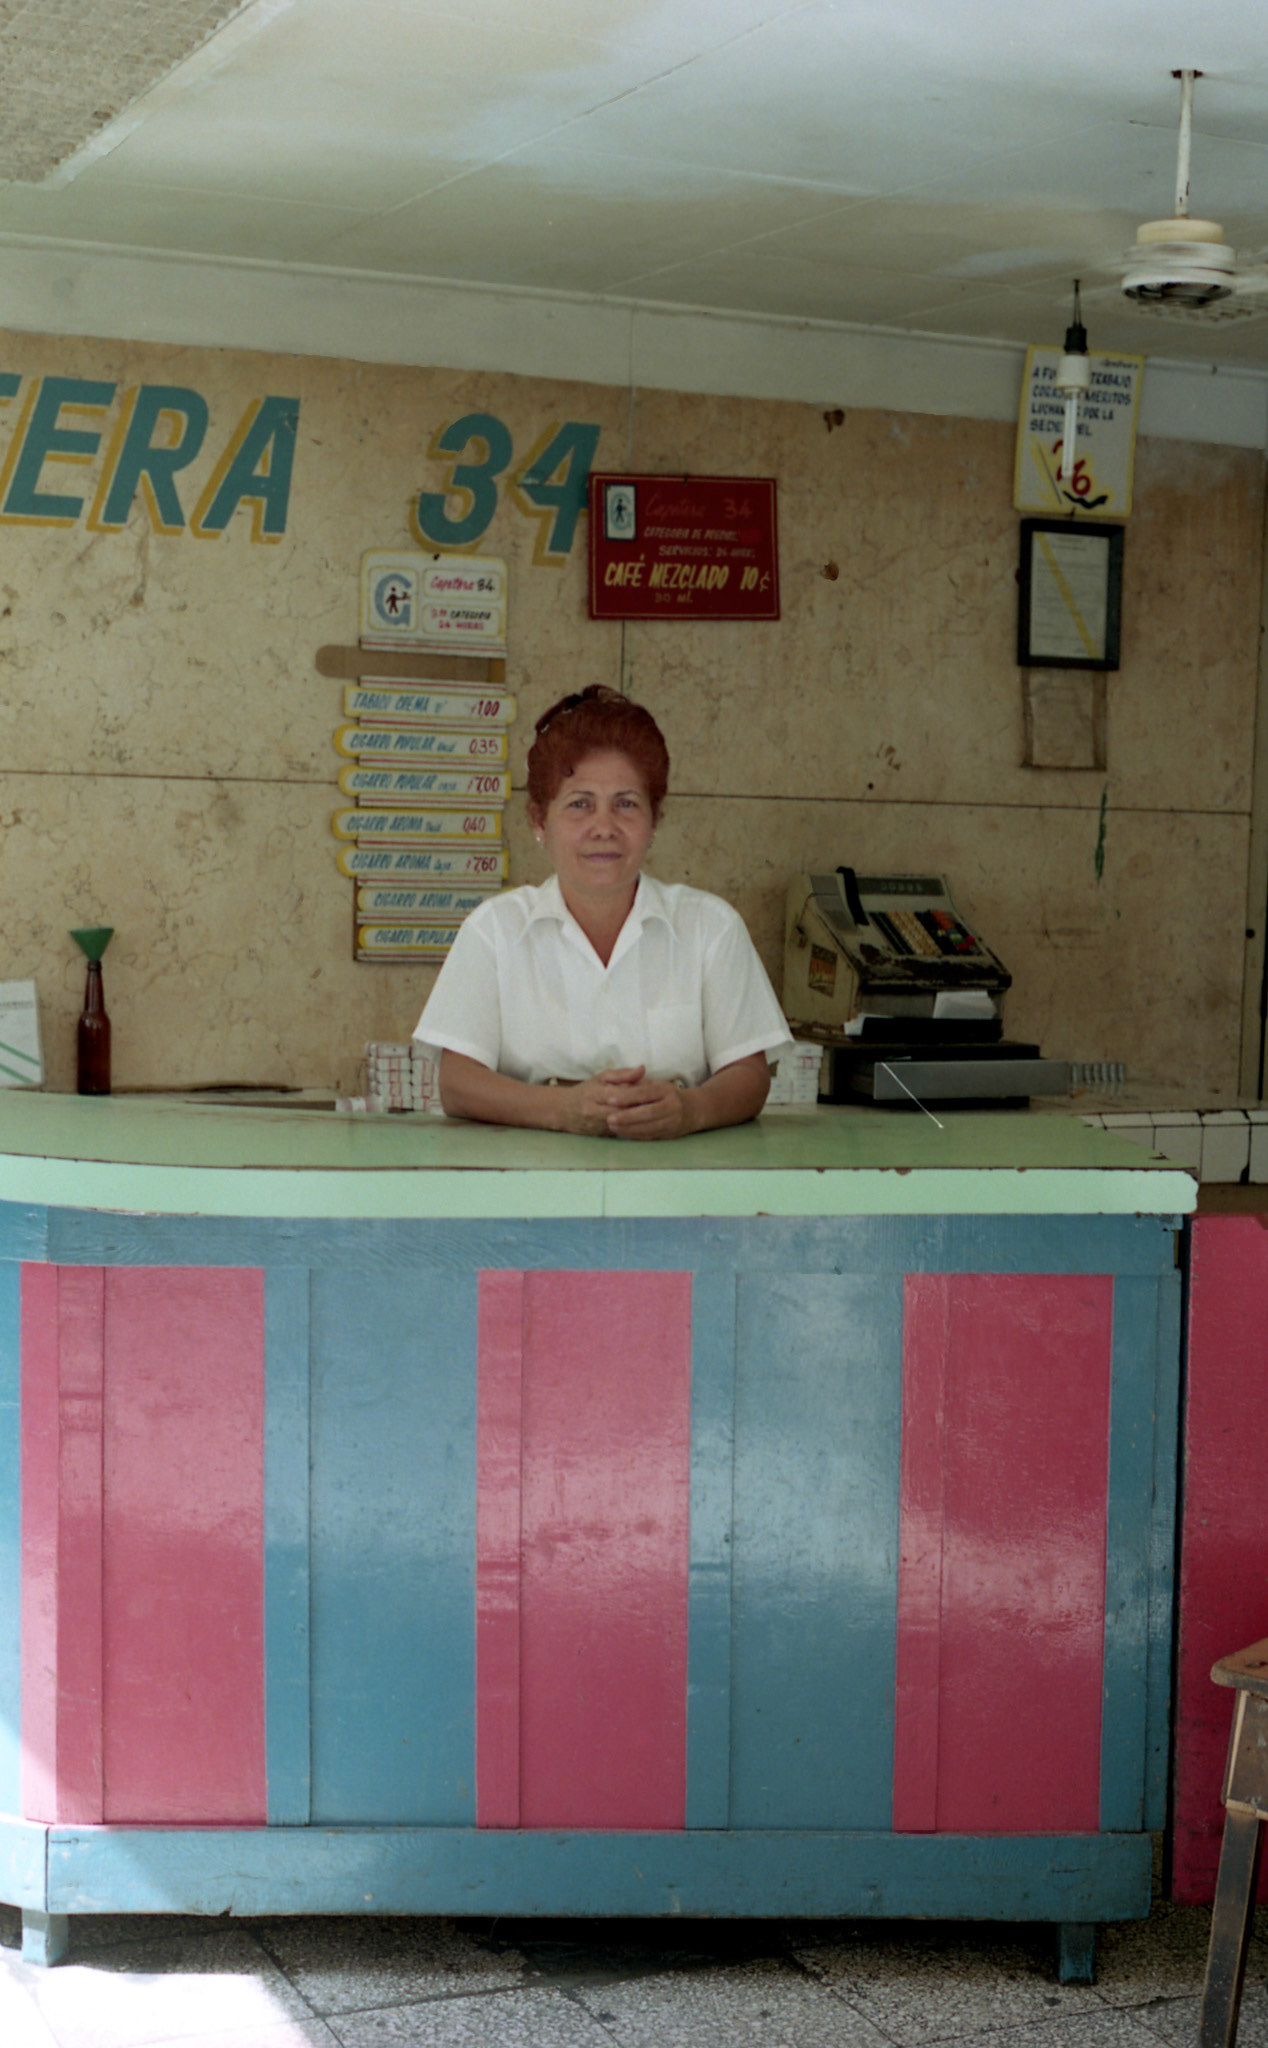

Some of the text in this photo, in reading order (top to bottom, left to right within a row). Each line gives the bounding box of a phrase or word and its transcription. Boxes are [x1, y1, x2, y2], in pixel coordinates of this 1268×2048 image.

[0, 374, 600, 568] ERA 34
[604, 553, 646, 587] CAFÉ
[648, 561, 730, 590] MEZCLADO
[350, 733, 392, 749] CIGARRO
[393, 734, 436, 750] POPULAR
[352, 773, 392, 789] CIGARRO
[393, 773, 438, 790] POPULAR
[346, 815, 388, 831] CIGARRO
[389, 816, 424, 832] AROMA
[351, 854, 392, 869] CIGARRO
[395, 854, 432, 870] AROMA
[374, 892, 416, 908] CIGARRO
[419, 892, 453, 908] AROMA
[375, 929, 459, 945] CIGARRO POPULA
